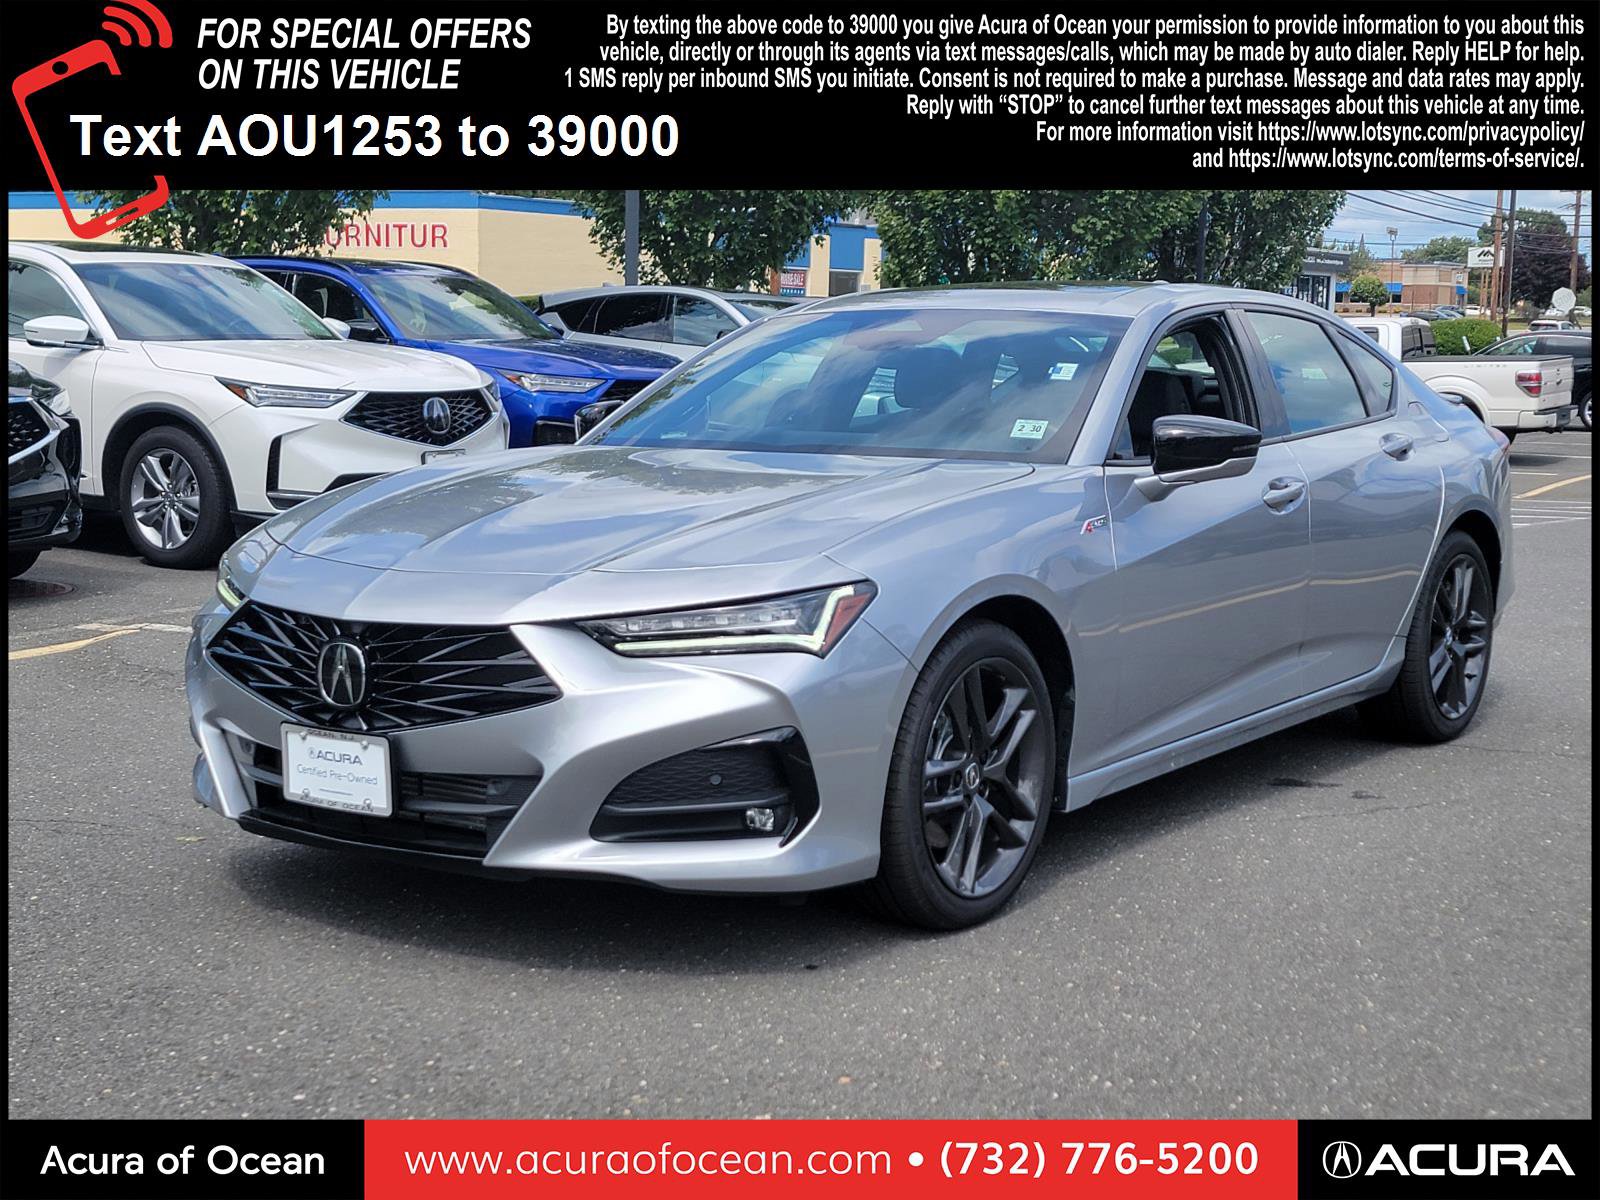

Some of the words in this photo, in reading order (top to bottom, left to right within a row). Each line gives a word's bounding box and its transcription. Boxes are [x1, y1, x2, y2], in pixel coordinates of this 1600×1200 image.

[324, 223, 449, 249] URNITUR
[1017, 424, 1026, 432] 2
[1029, 424, 1043, 433] 30
[316, 749, 363, 766] ACURA
[296, 763, 328, 778] Certified
[329, 768, 379, 786] Pre-Owned
